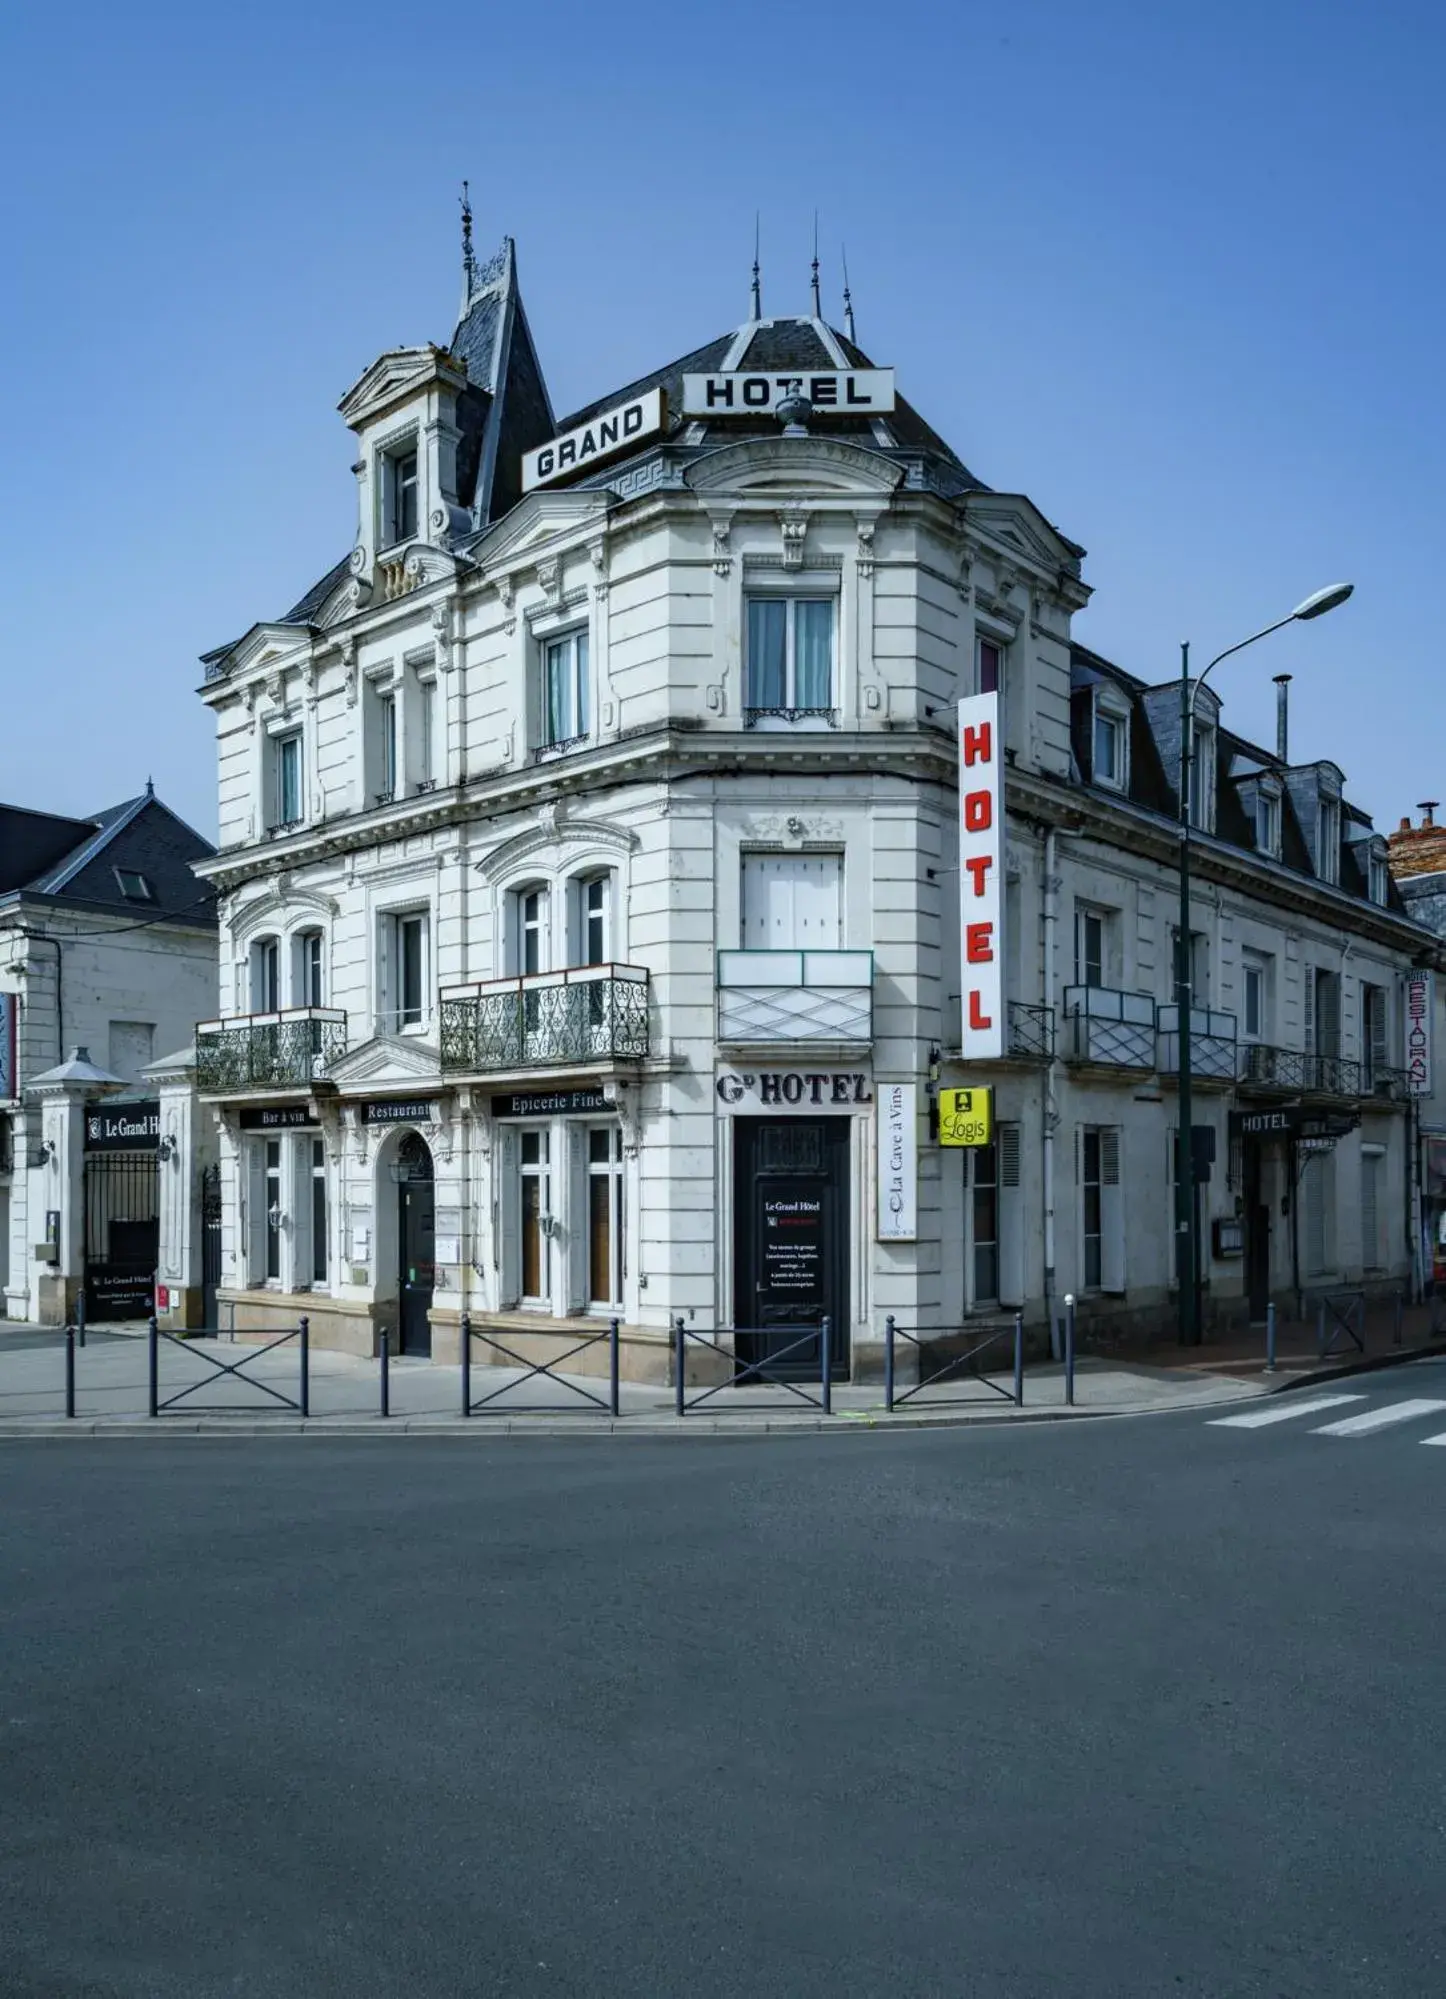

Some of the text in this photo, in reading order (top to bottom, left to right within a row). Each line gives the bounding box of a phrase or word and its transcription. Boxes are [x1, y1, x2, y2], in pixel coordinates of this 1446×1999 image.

[707, 376, 872, 407] HOTEL
[537, 404, 643, 478] GRAND
[964, 721, 993, 1030] HOTEL
[1408, 982, 1427, 1091] RESTAURANT
[512, 1093, 603, 1114] Epicerie Fine
[759, 1073, 874, 1105] HOTEL
[890, 1087, 903, 1120] Vins
[262, 1111, 278, 1125] Bar
[368, 1103, 430, 1118] Restaurant
[1242, 1111, 1291, 1131] HOTEL
[105, 1115, 160, 1137] Le Grand H
[941, 1114, 985, 1143] Logis
[890, 1135, 903, 1172] Cave
[890, 1177, 903, 1193] La
